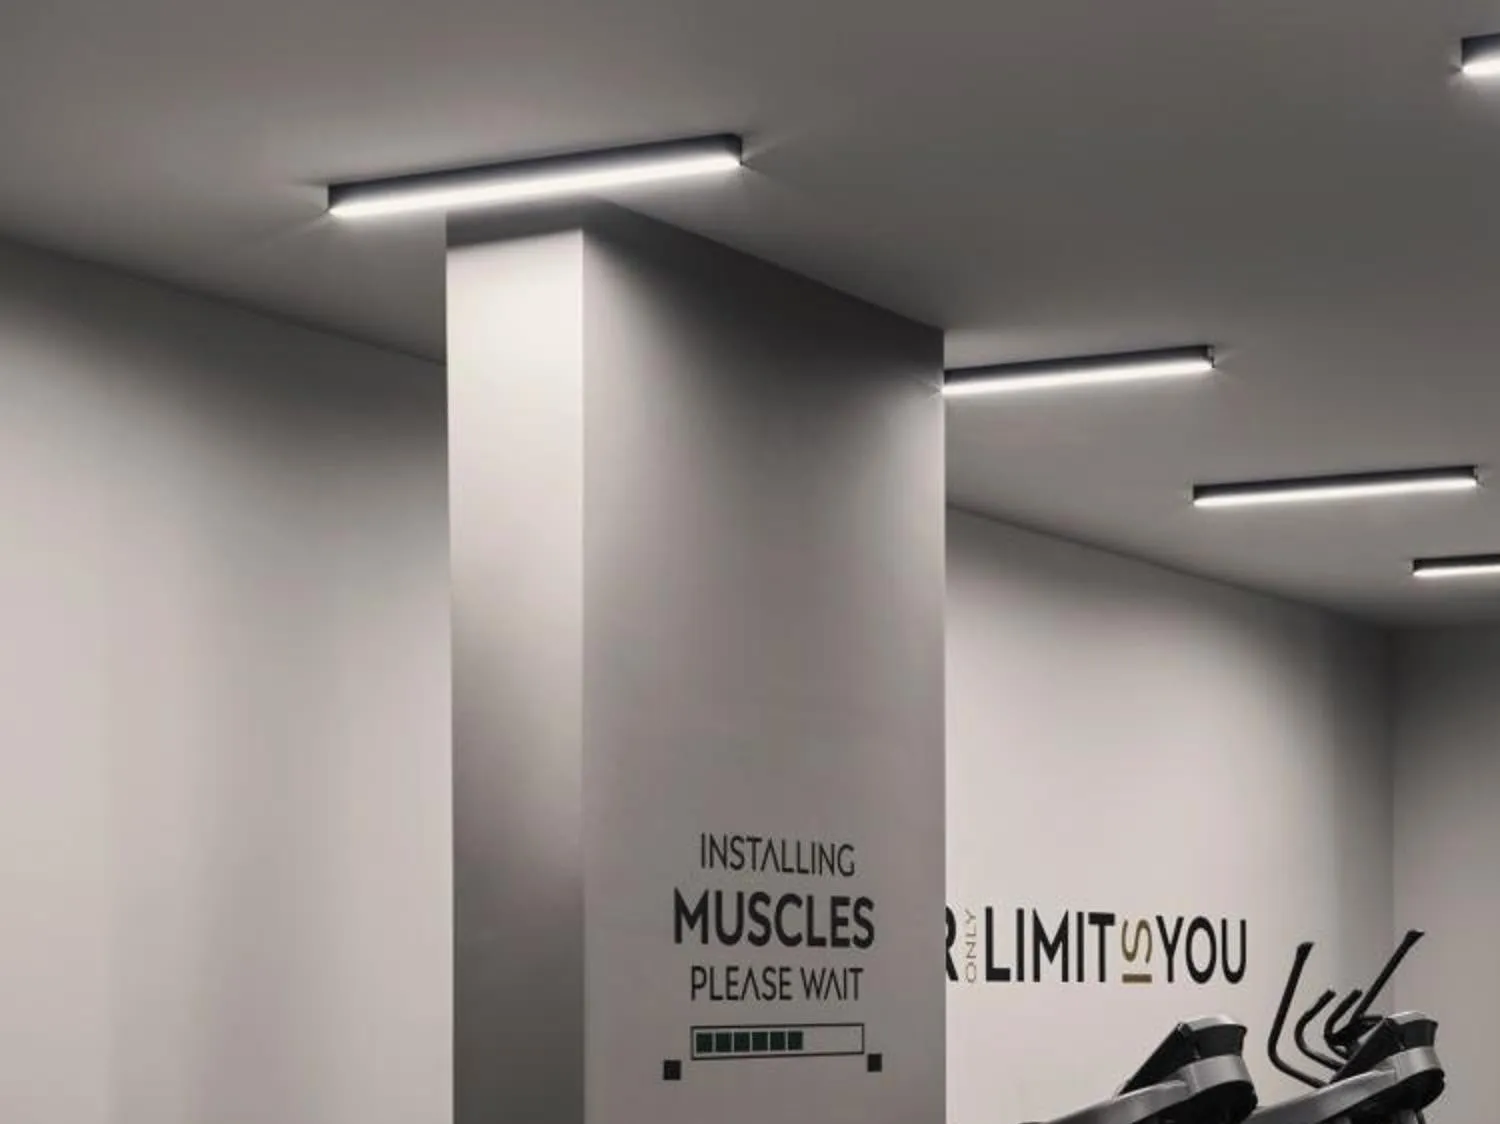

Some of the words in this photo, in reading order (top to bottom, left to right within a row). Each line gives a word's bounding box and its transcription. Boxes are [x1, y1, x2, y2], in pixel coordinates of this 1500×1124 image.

[701, 833, 854, 877] INSTALLING
[674, 887, 875, 949] MUSCLES
[964, 907, 978, 984] ONLY
[984, 906, 1116, 983] LIMIT
[1121, 918, 1153, 983] IS
[1156, 915, 1247, 984] YOU
[690, 965, 792, 1001] PLEASE
[800, 966, 864, 1001] WAIT
